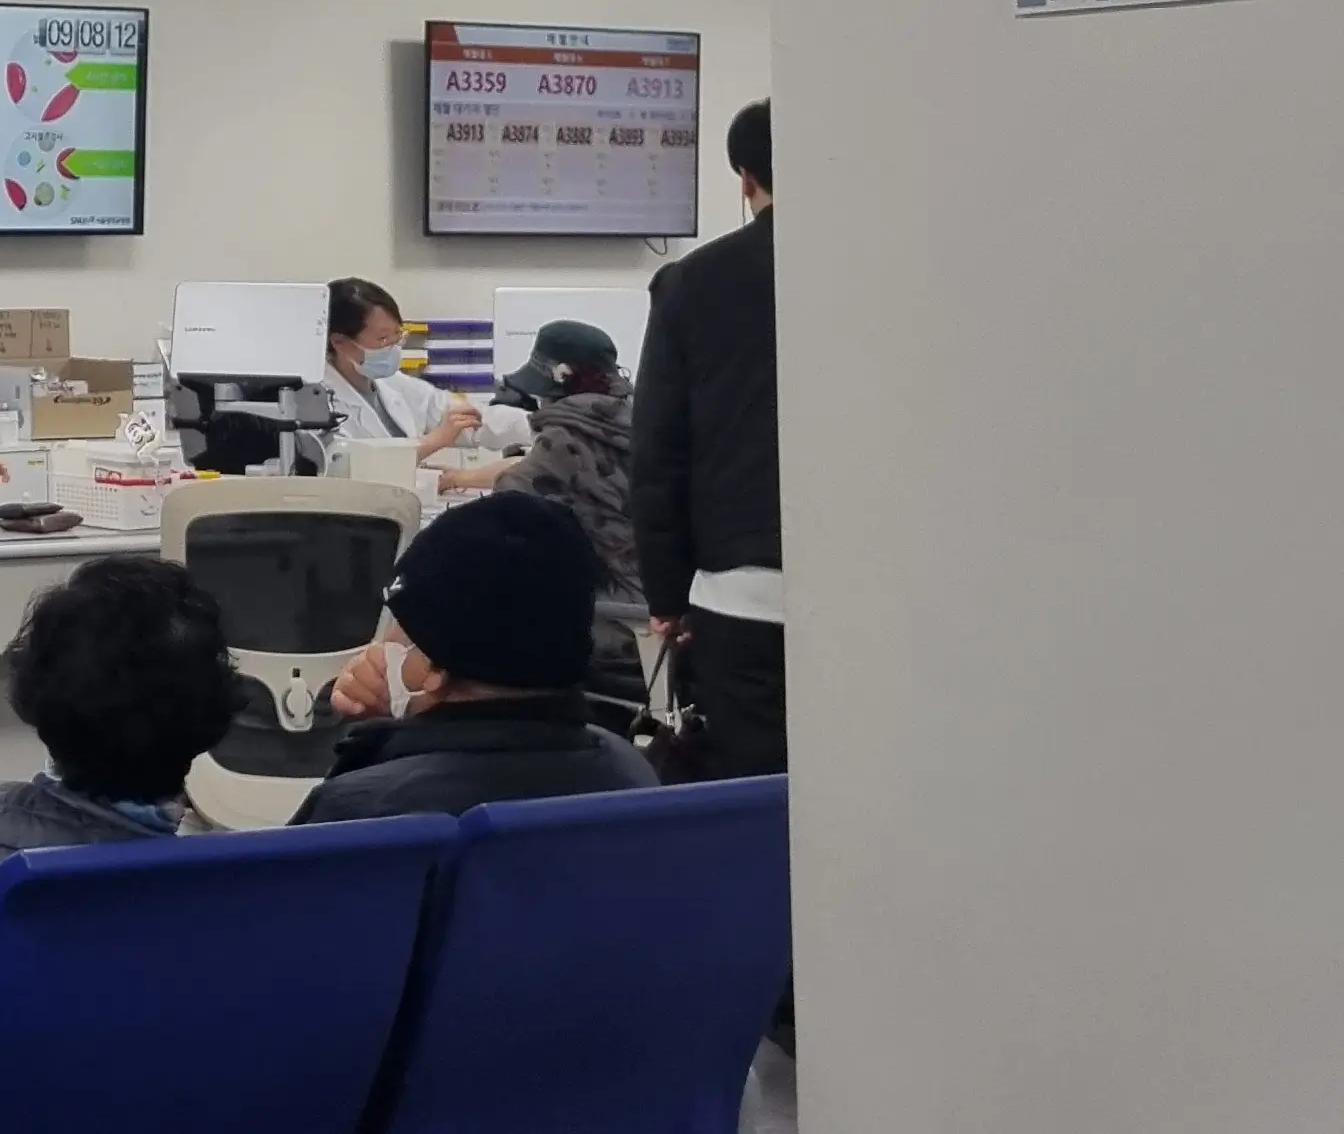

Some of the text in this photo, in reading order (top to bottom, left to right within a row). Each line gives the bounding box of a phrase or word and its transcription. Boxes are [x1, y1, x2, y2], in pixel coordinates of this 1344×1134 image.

[48, 20, 72, 46] 09
[80, 21, 104, 47] 08
[115, 23, 135, 47] 12
[447, 71, 684, 99] A3359 A3870 A3913
[447, 123, 484, 142] A3913
[502, 125, 539, 143] A3874
